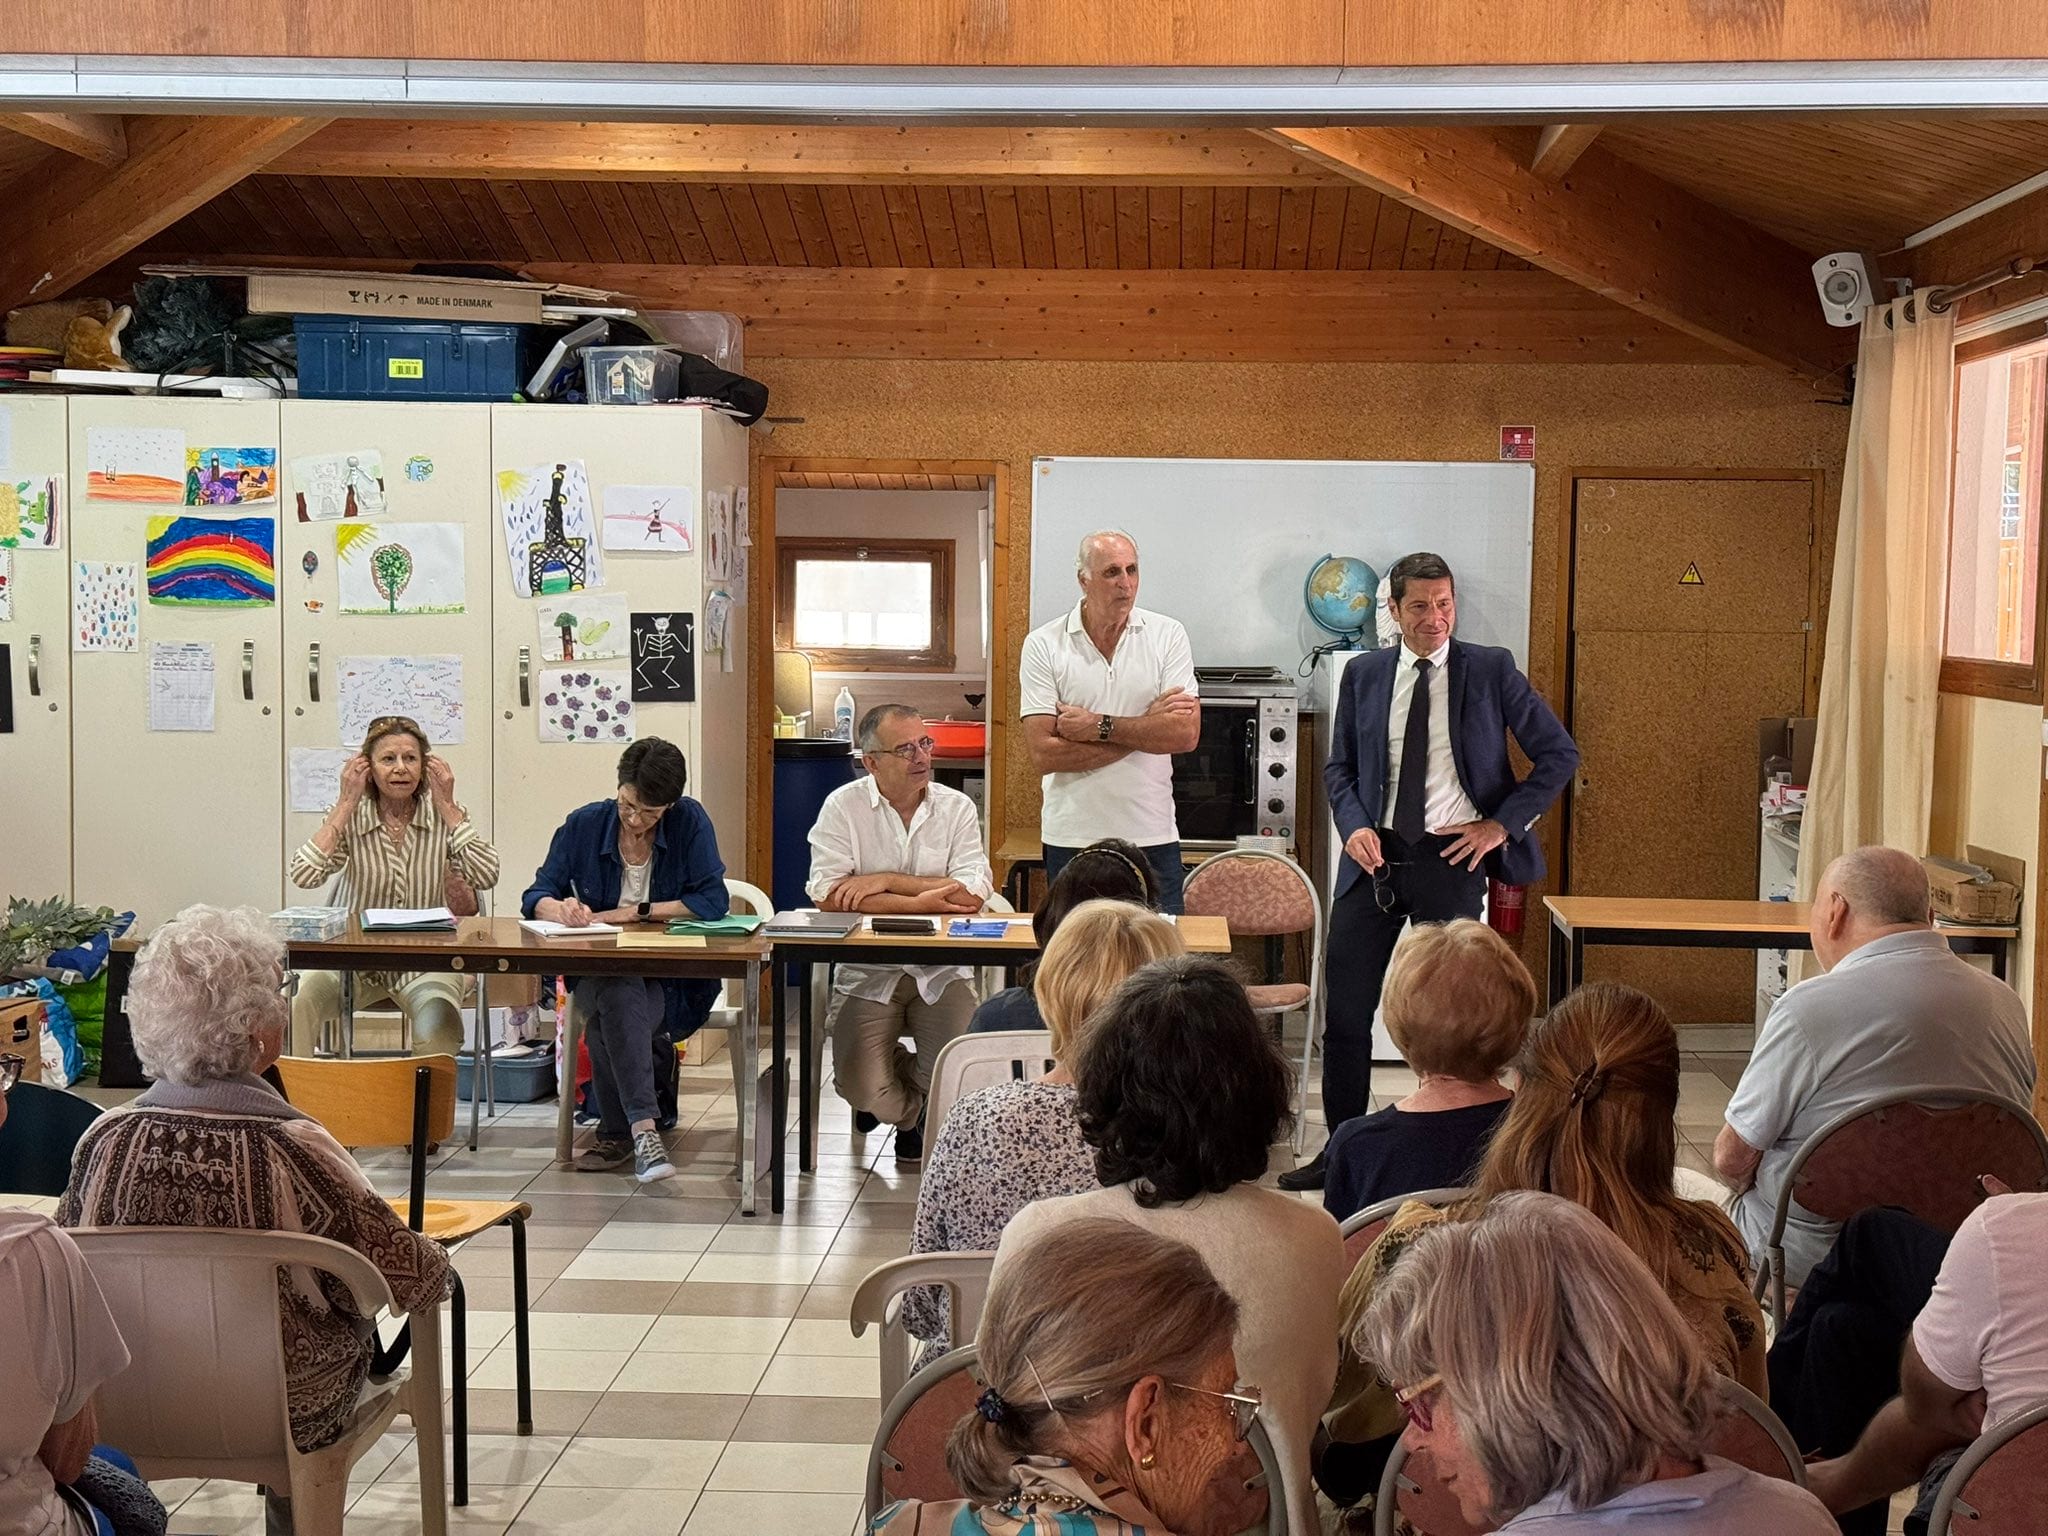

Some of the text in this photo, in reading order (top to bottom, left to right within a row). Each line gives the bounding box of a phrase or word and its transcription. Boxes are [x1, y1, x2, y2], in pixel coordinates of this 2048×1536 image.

[417, 296, 493, 309] MADE IN DENMARK
